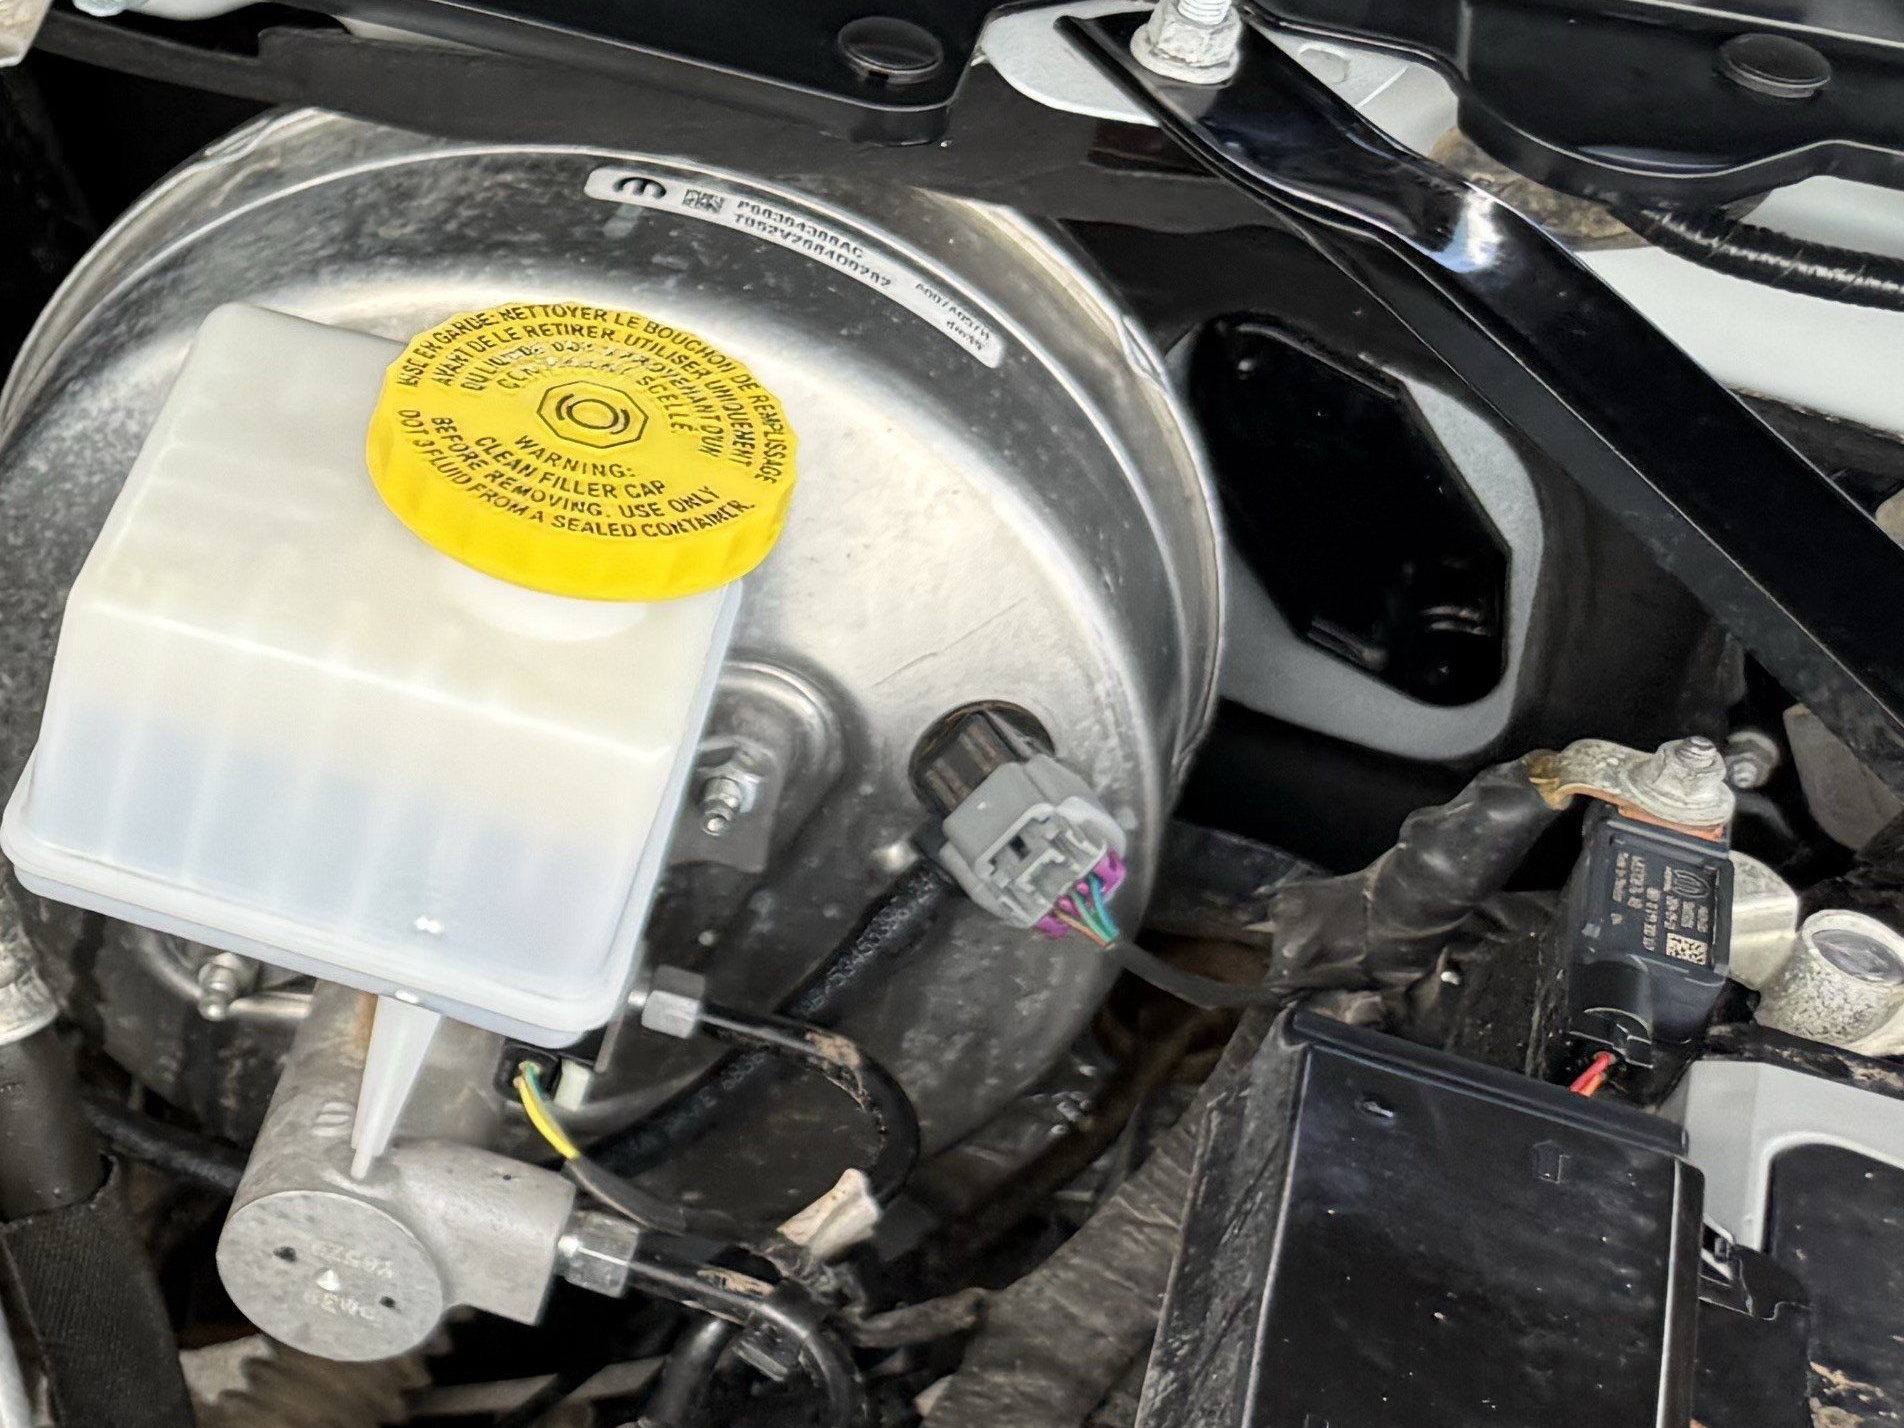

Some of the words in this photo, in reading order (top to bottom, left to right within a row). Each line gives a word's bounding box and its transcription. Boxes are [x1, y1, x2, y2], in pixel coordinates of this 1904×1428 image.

[429, 346, 475, 387] AVANT
[465, 334, 497, 354] DE
[491, 325, 523, 344] LE
[623, 333, 714, 381] UTILISER
[703, 379, 756, 468] UNIQUEMENT
[498, 303, 608, 322] NETTOYER
[614, 312, 641, 330] LE
[643, 320, 737, 374] BOUCHON
[729, 372, 762, 393] DE
[748, 394, 788, 485] REMPLISSAGE
[397, 409, 430, 435] DOT
[411, 439, 436, 449] 3
[514, 434, 637, 479] WARNING:
[421, 448, 473, 486] FLUID
[430, 416, 490, 471] BEFORE
[483, 469, 611, 519] REMOVING.
[618, 501, 666, 519] USE
[667, 485, 721, 514] ONLY
[474, 436, 539, 479] CLEAN
[538, 470, 618, 499] FILLER
[624, 479, 666, 499] CAP
[465, 481, 531, 516] FROM
[529, 510, 544, 524] A
[550, 514, 638, 538] SEALED
